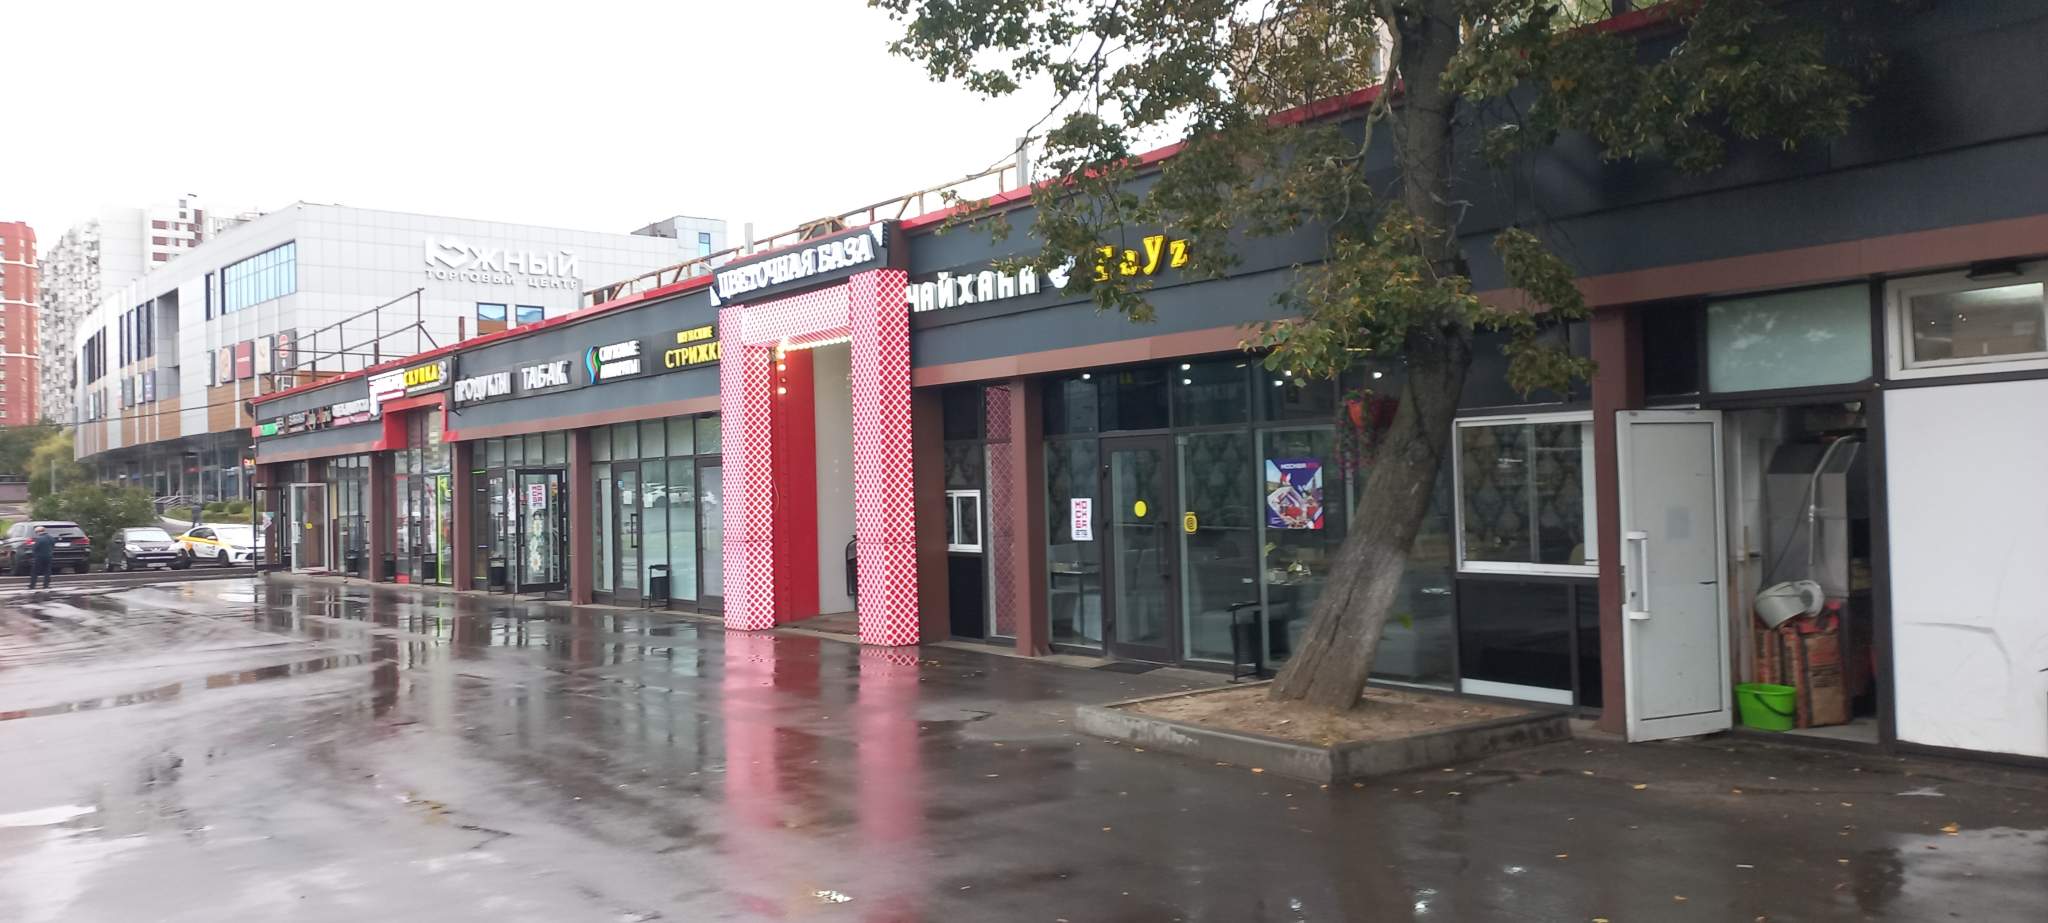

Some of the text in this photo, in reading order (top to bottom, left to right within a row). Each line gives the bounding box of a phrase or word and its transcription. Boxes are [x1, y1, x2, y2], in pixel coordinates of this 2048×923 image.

[424, 236, 580, 279] ЮЖНЫЙ
[717, 235, 875, 299] ЦВЕТОЧНАЯ БАЗА
[425, 268, 579, 291] ТОРГОВЫЙ ЦЕНТР
[454, 371, 511, 401] ПРОДУКТЫ
[521, 360, 573, 391] ТАБАК
